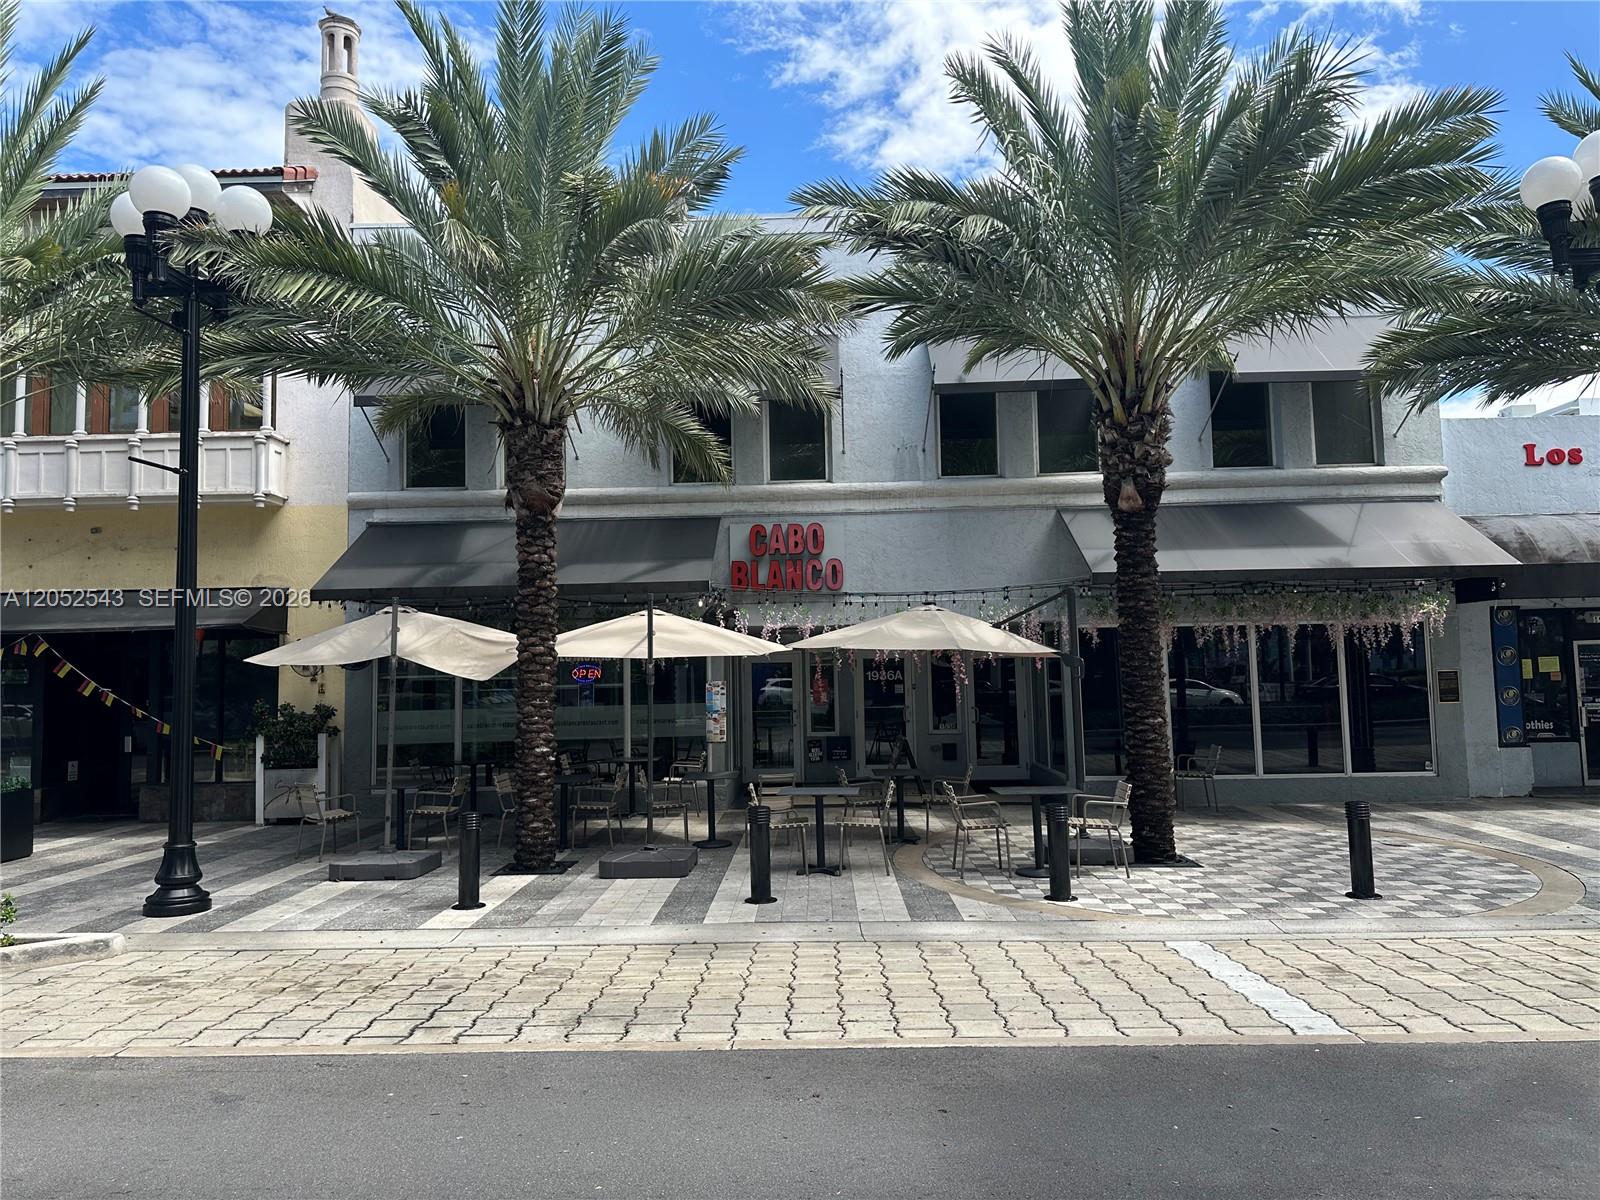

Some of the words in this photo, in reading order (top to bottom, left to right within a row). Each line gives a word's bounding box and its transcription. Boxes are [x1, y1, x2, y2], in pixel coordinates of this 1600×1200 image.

[1523, 443, 1583, 466] Los
[749, 523, 824, 557] CABO
[730, 558, 844, 592] BLANCO
[571, 668, 602, 679] OPEN
